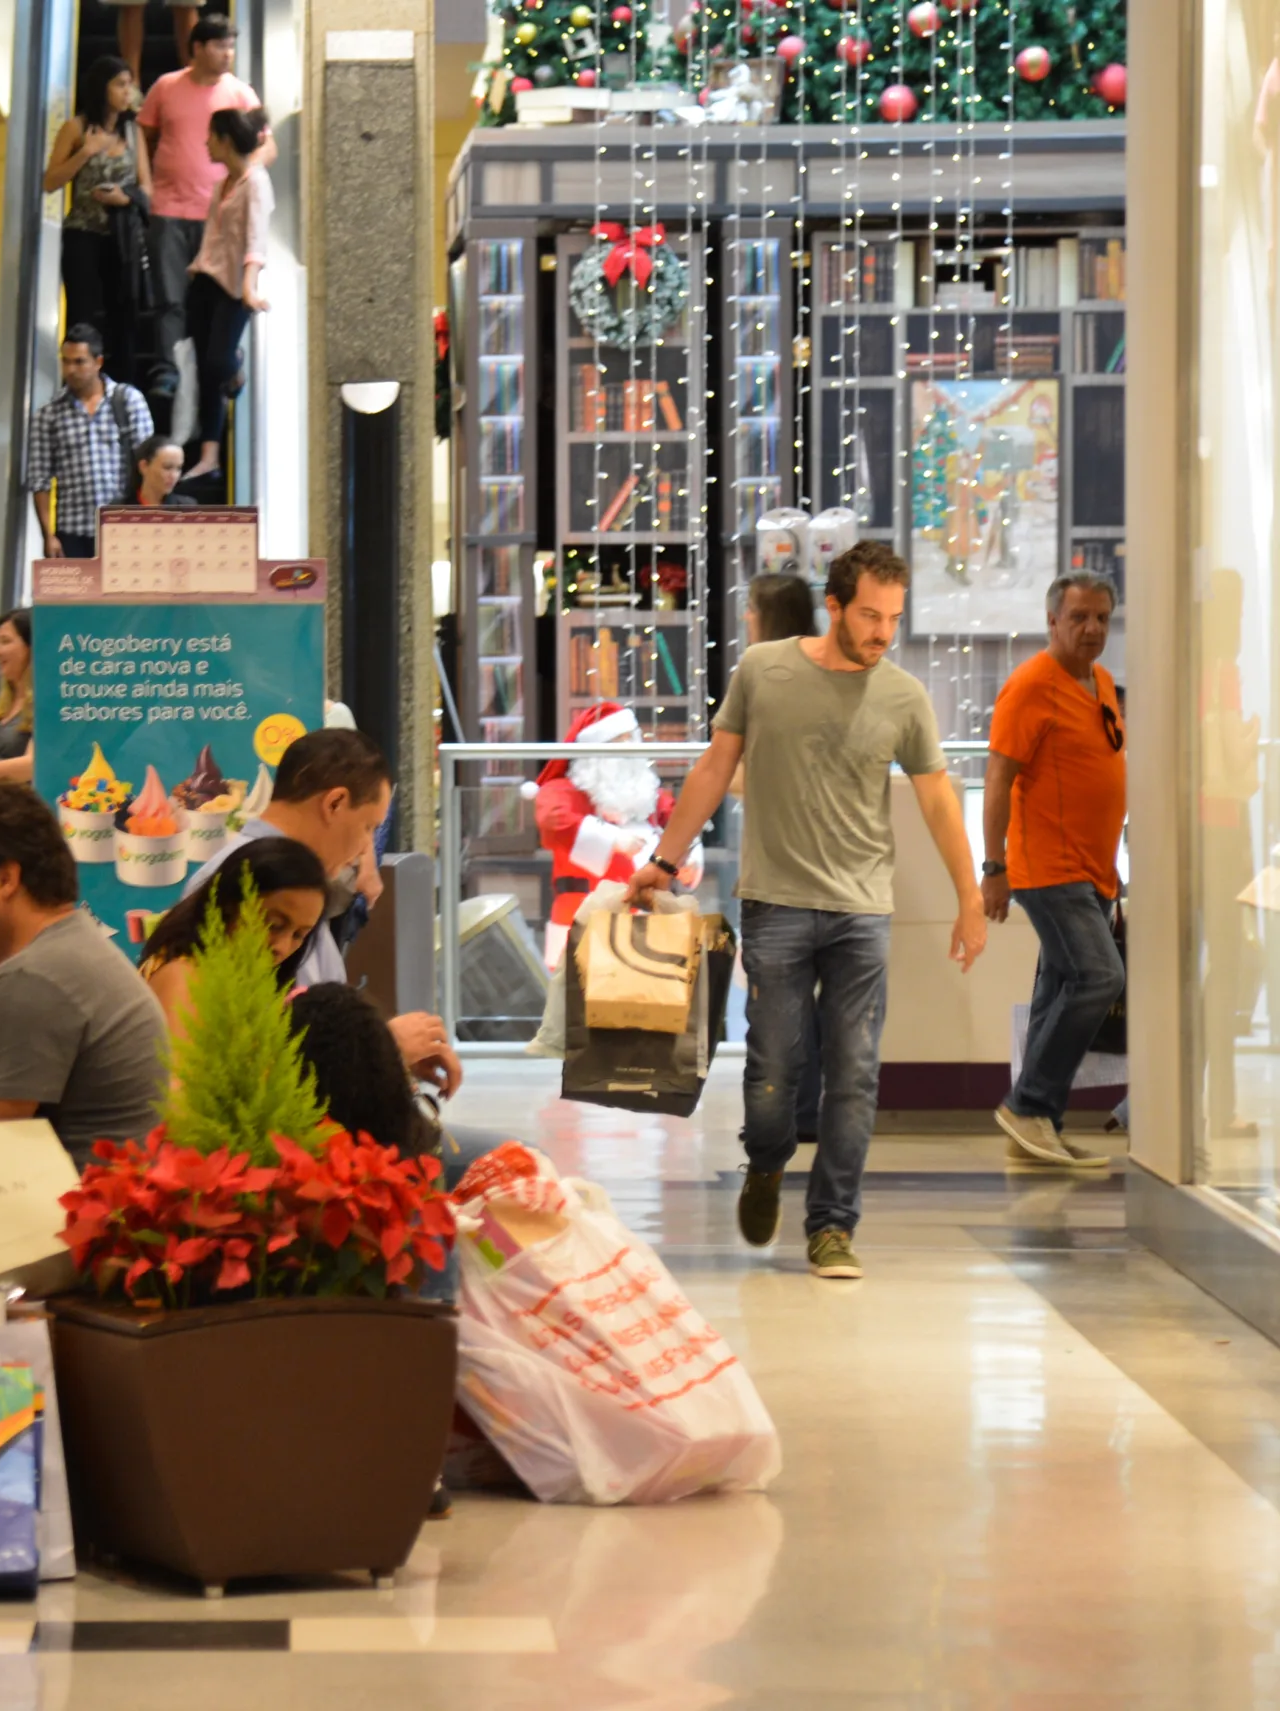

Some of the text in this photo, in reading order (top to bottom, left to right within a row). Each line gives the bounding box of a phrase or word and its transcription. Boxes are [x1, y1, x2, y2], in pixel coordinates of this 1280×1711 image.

[58, 633, 232, 657] A Yogoberry está
[59, 657, 209, 676] de cara nova e
[60, 679, 244, 698] trouxe ainda mais
[59, 702, 143, 721] sabores
[147, 705, 195, 724] para
